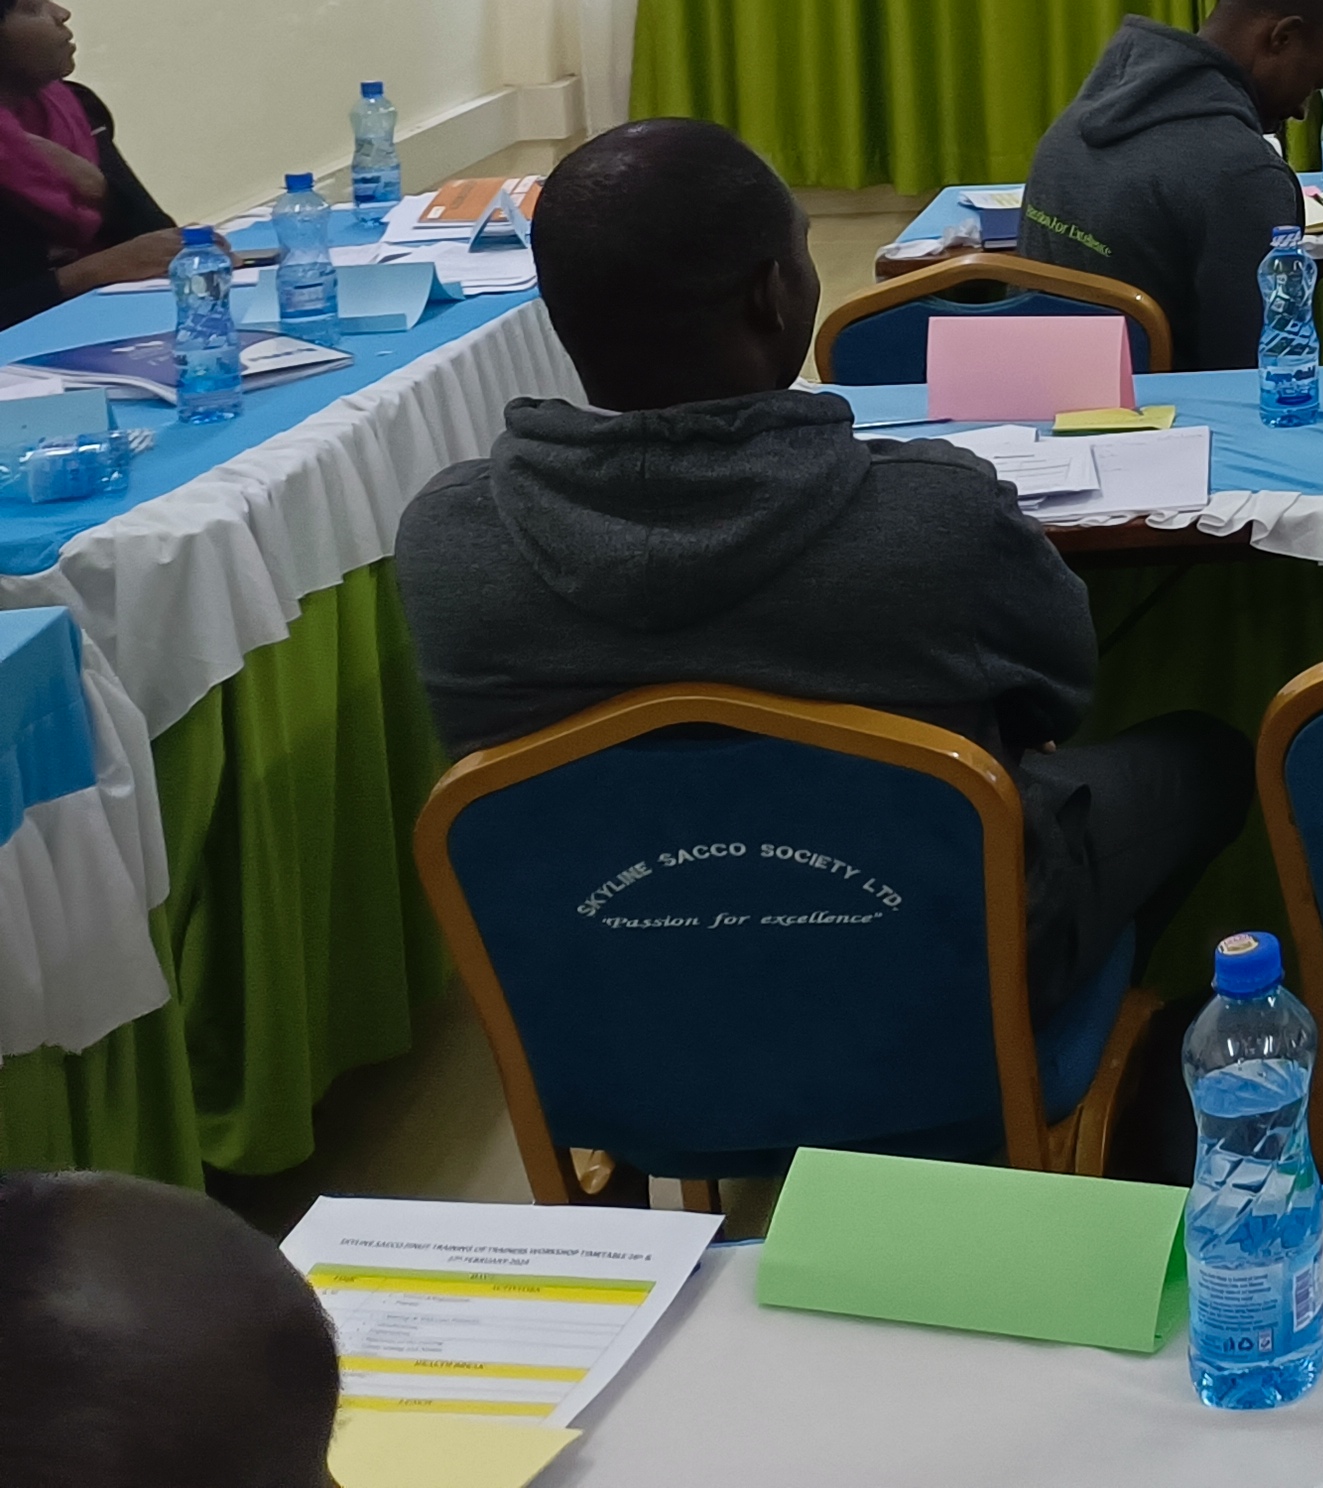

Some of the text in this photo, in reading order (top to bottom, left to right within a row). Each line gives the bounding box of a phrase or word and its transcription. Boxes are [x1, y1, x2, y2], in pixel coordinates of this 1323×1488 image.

[576, 861, 653, 918] SKYLINE
[657, 842, 747, 868] SACCO
[760, 843, 861, 881] SOCIETY
[707, 912, 752, 930] for
